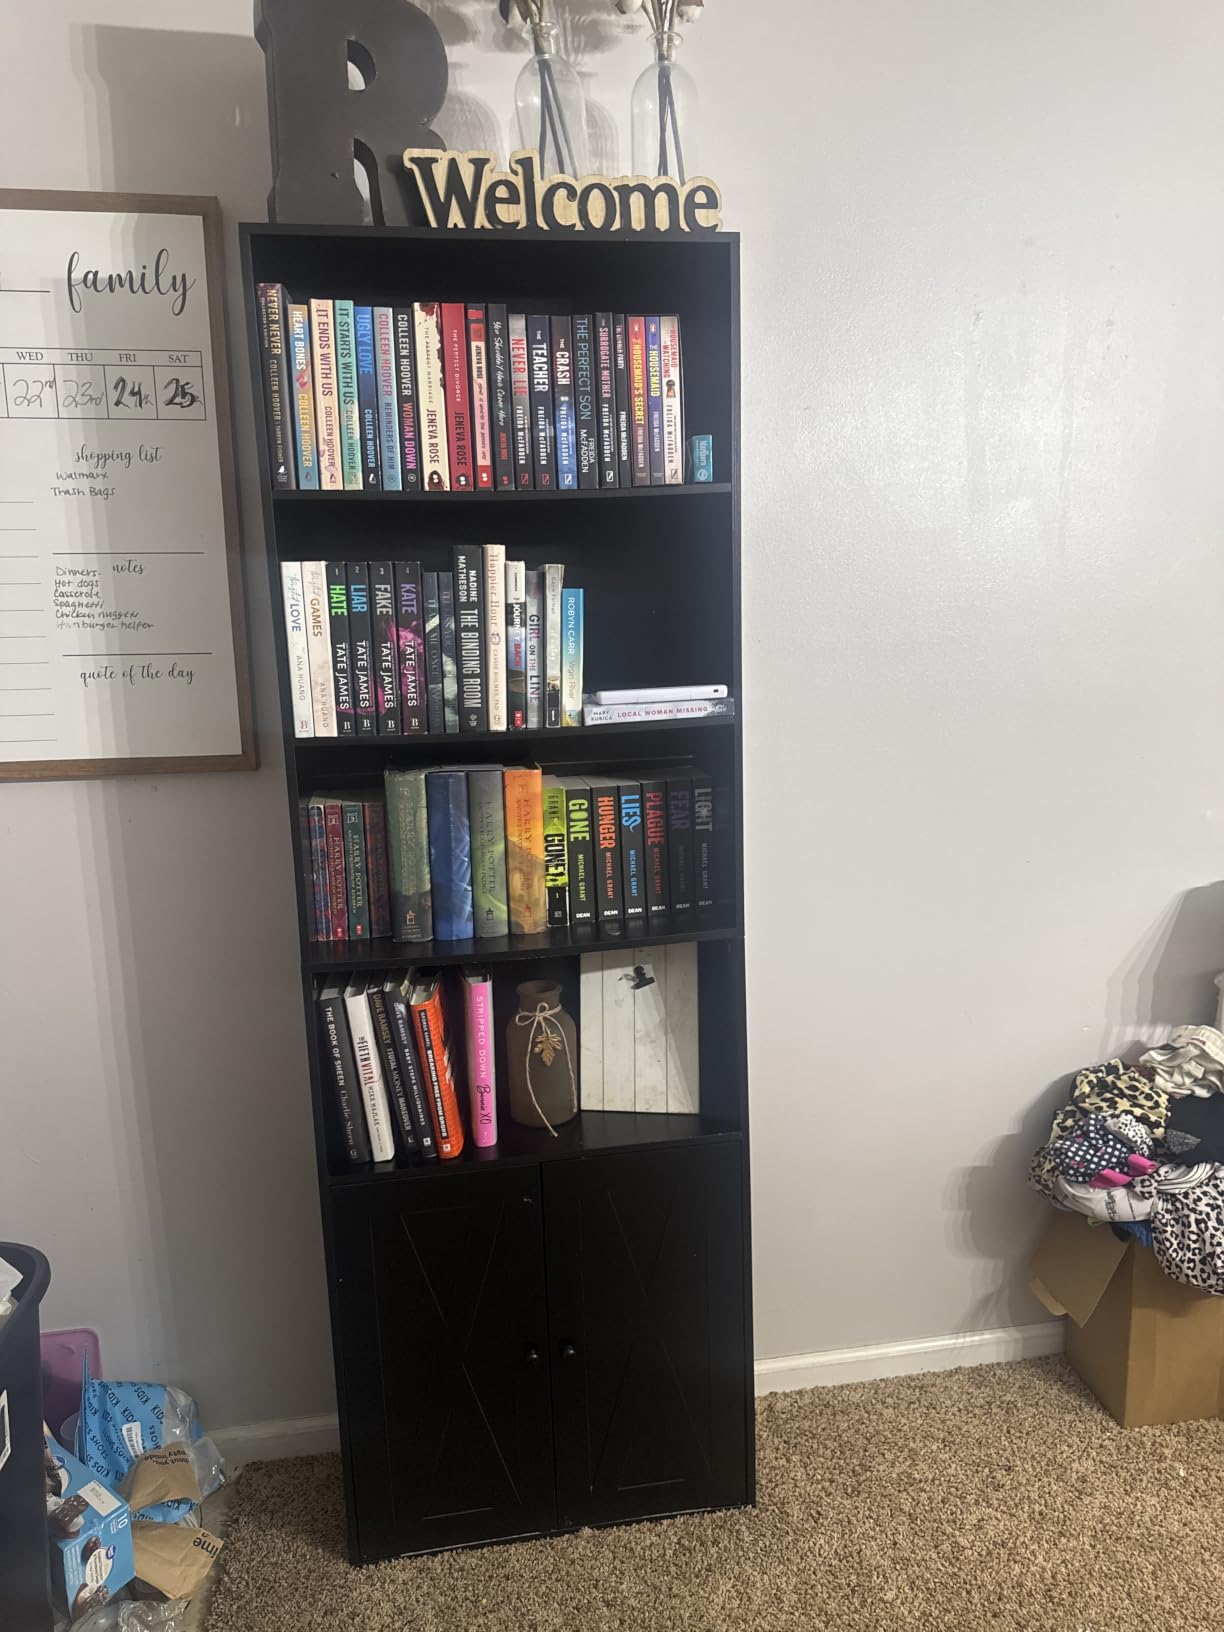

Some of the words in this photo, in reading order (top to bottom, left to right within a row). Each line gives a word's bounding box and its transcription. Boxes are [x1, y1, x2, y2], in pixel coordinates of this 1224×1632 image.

[404, 149, 721, 230] Welcome
[67, 248, 196, 316] family
[266, 289, 279, 320] NEVER
[317, 308, 328, 319] IT
[339, 308, 349, 318] IT
[293, 311, 304, 338] HEART
[318, 322, 331, 349] ENDS
[356, 314, 371, 343] UGLY
[493, 321, 503, 334] You
[576, 318, 588, 339] THE
[269, 324, 281, 355] NEVER
[340, 321, 352, 358] STARTS
[599, 327, 611, 368] SURROGATE
[16, 351, 44, 361] WED
[67, 352, 93, 362] THU
[119, 353, 137, 363] FRI
[168, 354, 190, 364] SAT
[295, 341, 306, 370] BONES
[320, 353, 332, 379] WITH
[358, 346, 372, 374] LOVE
[511, 338, 525, 373] NEVER
[532, 343, 548, 392] TEACHER
[556, 351, 570, 385] CRASH
[577, 343, 590, 391] PERFECT
[662, 345, 671, 378] WATCHING
[269, 360, 278, 391] COLLEEN
[342, 362, 353, 388] WITH
[496, 371, 504, 387] Have
[632, 344, 643, 396] HOUSEMAID'S
[649, 351, 660, 396] HOUSEMAID
[322, 383, 333, 397] US
[513, 379, 527, 396] LIE
[601, 370, 611, 398] MOTHER
[271, 393, 281, 420] HOOVER
[343, 391, 354, 405] US
[496, 389, 505, 408] Come
[580, 395, 591, 420] SON
[635, 397, 645, 424] SECRET
[298, 393, 310, 431] COLLEEN
[384, 402, 394, 442] REMINDERS
[402, 403, 414, 438] WOMAN
[427, 409, 438, 441] JENEVA
[454, 411, 465, 441] JENEVA
[75, 445, 134, 469] shopping
[138, 444, 161, 463] list
[301, 433, 312, 467] HOOVER
[386, 445, 394, 454] OF
[405, 441, 417, 469] DOWN
[429, 442, 440, 464] ROSE
[456, 445, 467, 467] ROSE
[517, 431, 526, 464] McFADDEN
[538, 431, 547, 465] McFADDEN
[580, 430, 589, 473] McFADDEN
[387, 456, 395, 470] HIM
[51, 486, 86, 496] Trash
[89, 487, 115, 499] Bags
[112, 560, 144, 574] notes
[457, 556, 467, 602] MATHESON
[488, 554, 499, 597] Happier
[54, 589, 101, 598] Casserole
[55, 579, 74, 588] Hot
[77, 579, 99, 590] dogs
[469, 570, 477, 602] NADINE
[53, 599, 104, 610] Spaghetti
[330, 585, 347, 616] HATE
[351, 585, 367, 612] LIAR
[375, 584, 392, 616] FAKE
[400, 583, 416, 614] KATE
[56, 609, 95, 619] Chicken
[290, 603, 301, 632] LOVE
[310, 598, 322, 637] GAMES
[460, 609, 478, 628] THE
[490, 600, 500, 627] Hour
[512, 604, 520, 641] JOURNEY
[529, 614, 540, 641] GIRL
[296, 655, 304, 672] ANA
[336, 642, 347, 669] TATE
[356, 640, 367, 667] TATE
[381, 642, 391, 668] TATE
[461, 632, 480, 674] BINDING
[529, 645, 536, 656] ON
[80, 665, 116, 687] quote
[122, 665, 135, 684] of
[141, 664, 163, 679] the
[168, 663, 196, 684] day
[298, 674, 306, 701] HUANG
[530, 675, 540, 702] LINE
[336, 672, 349, 709] JAMES
[356, 670, 369, 708] JAMES
[380, 671, 394, 708] JAMES
[463, 678, 482, 708] ROOM
[617, 710, 641, 718] LOCAL
[645, 708, 674, 716] WOMAN
[548, 796, 560, 819] GRANT
[569, 799, 590, 842] GONE
[621, 794, 642, 833] LIES
[645, 792, 664, 846] PLAGUE
[670, 792, 690, 830] FEAR
[695, 788, 713, 832] LIGHT
[597, 796, 616, 849] HUNGER
[333, 837, 342, 871] HARRY
[353, 834, 362, 869] HARRY
[605, 852, 613, 878] MICHAEL
[354, 872, 363, 907] POTTER
[324, 1006, 334, 1022] THE
[373, 994, 384, 1013] DAVE
[378, 1014, 391, 1044] RAMSEY
[393, 1003, 402, 1019] DAVE
[398, 1020, 407, 1044] RAMSEY
[476, 996, 485, 1045] STRIPPED
[328, 1024, 338, 1046] BOOK
[332, 1048, 340, 1058] OF
[356, 1040, 371, 1063] FIFTH
[387, 1050, 398, 1070] TOTAL
[404, 1049, 413, 1064] BABY
[479, 1050, 487, 1078] DOWN
[334, 1060, 345, 1086] SHEEN
[360, 1063, 375, 1086] VITAL
[408, 1066, 417, 1084] STEPS
[427, 1050, 438, 1081] BREAKING
[392, 1071, 404, 1097] MONEY
[432, 1083, 440, 1098] FREE
[412, 1085, 426, 1126] MILLIONAIRES
[434, 1098, 443, 1115] FROM
[476, 1085, 491, 1111] Bunnie
[339, 1090, 351, 1120] Charlie
[345, 1120, 356, 1145] Sheen
[399, 1097, 411, 1130] MAKEOVER
[439, 1116, 448, 1137] BROKE
[480, 1112, 491, 1125] XO
[134, 1386, 151, 1405] KIDS
[91, 1436, 108, 1459] SHOES
[92, 1459, 111, 1478] KIDS
[117, 1513, 128, 1529] 10
